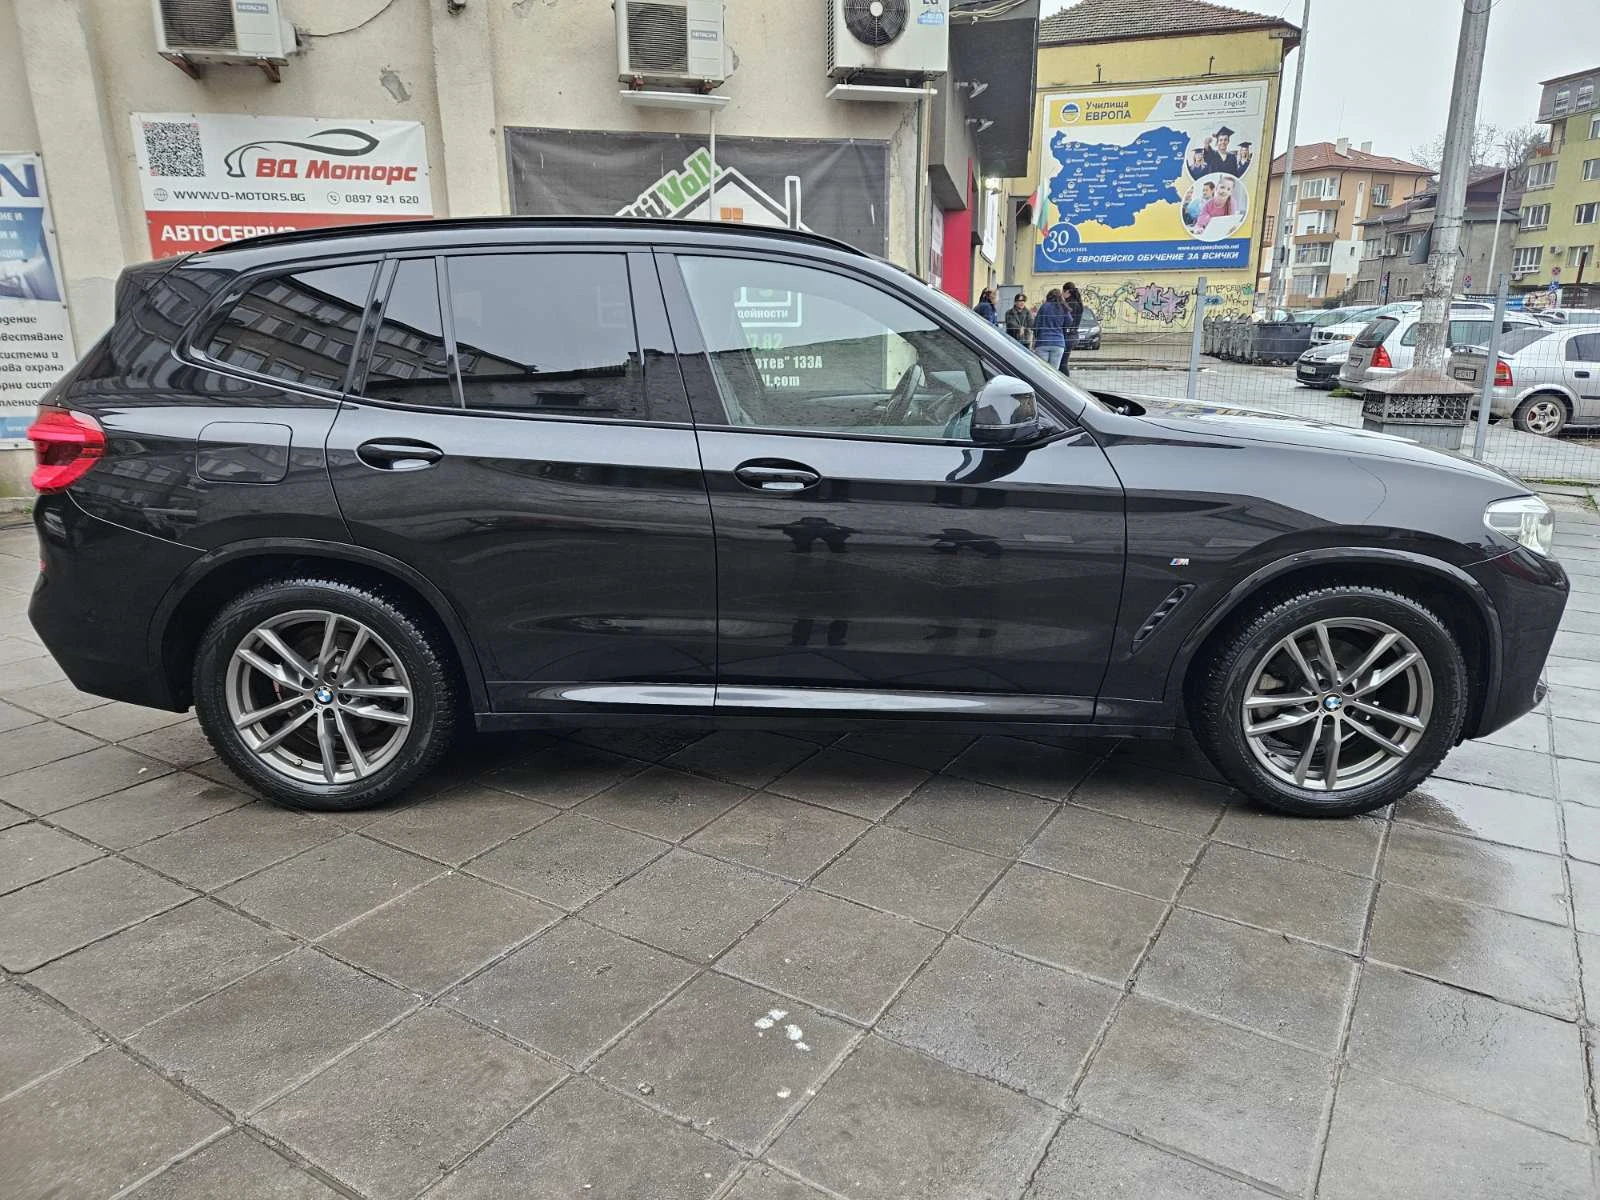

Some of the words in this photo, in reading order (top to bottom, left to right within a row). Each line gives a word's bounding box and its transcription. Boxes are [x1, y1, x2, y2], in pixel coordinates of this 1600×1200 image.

[1191, 91, 1248, 101] CAMBRIDGE
[1086, 101, 1129, 109] Училища
[1224, 99, 1247, 107] English
[1085, 110, 1131, 121] ЕВРОПА
[305, 159, 418, 185] Моторс
[173, 190, 306, 202] WWW.VD-MOTORS.BG
[345, 194, 371, 203] 0897
[376, 195, 395, 204] 921
[399, 195, 419, 204] 620
[161, 225, 297, 241] АВТОСЕРВ
[1046, 230, 1069, 252] 30
[1076, 252, 1134, 263] ЕВРОПЕЙСКО
[1137, 252, 1184, 262] ОБУЧЕНИЕ
[1187, 252, 1199, 261] ЗА
[1202, 251, 1240, 260] ВСИЧКИ
[0, 332, 64, 341] вестяване
[0, 364, 22, 372] ова
[25, 364, 64, 374] охрана
[0, 383, 22, 392] рни
